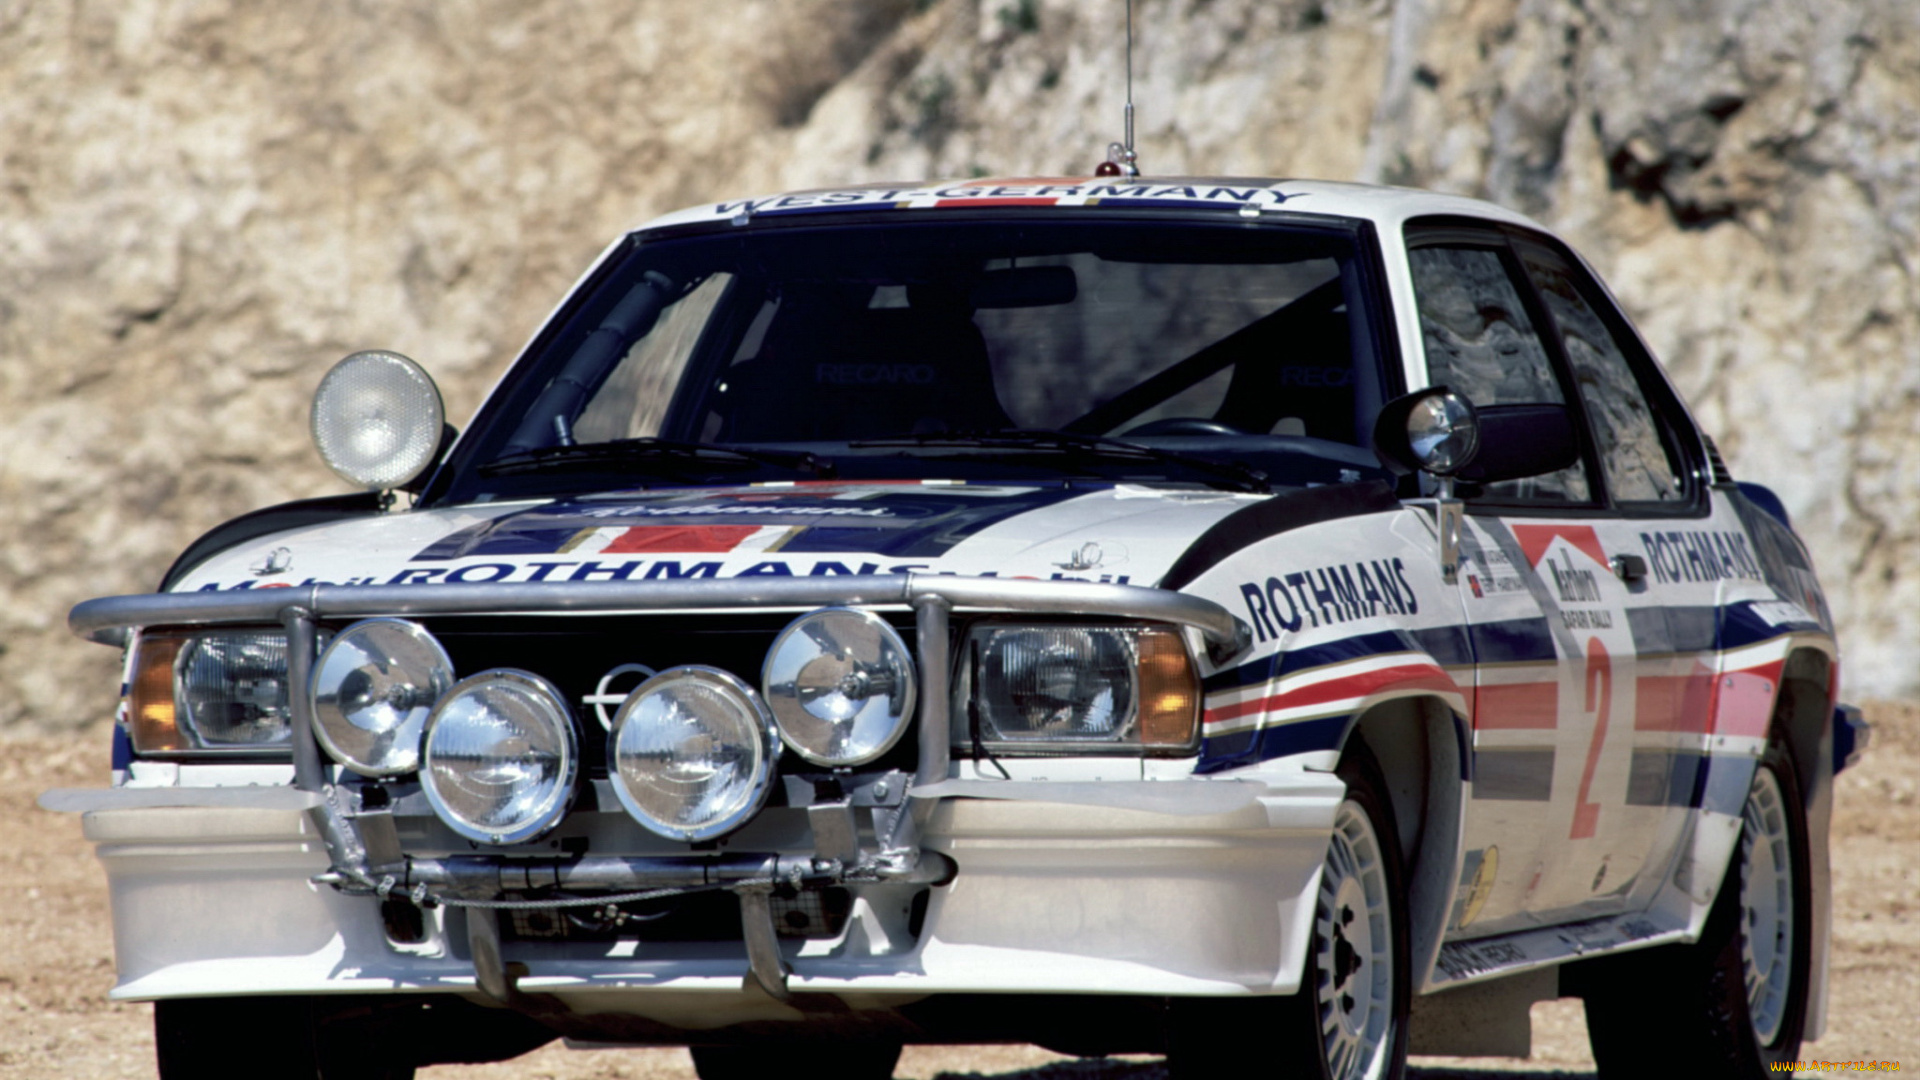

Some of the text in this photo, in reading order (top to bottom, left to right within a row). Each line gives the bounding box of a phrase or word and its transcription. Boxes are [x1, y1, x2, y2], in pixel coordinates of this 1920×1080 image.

[715, 185, 1312, 215] WEST-GERMANY
[816, 363, 935, 384] RECARO
[1640, 531, 1762, 584] ROTHMANS
[1239, 556, 1419, 643] ROTHMANS
[1569, 636, 1612, 840] 2
